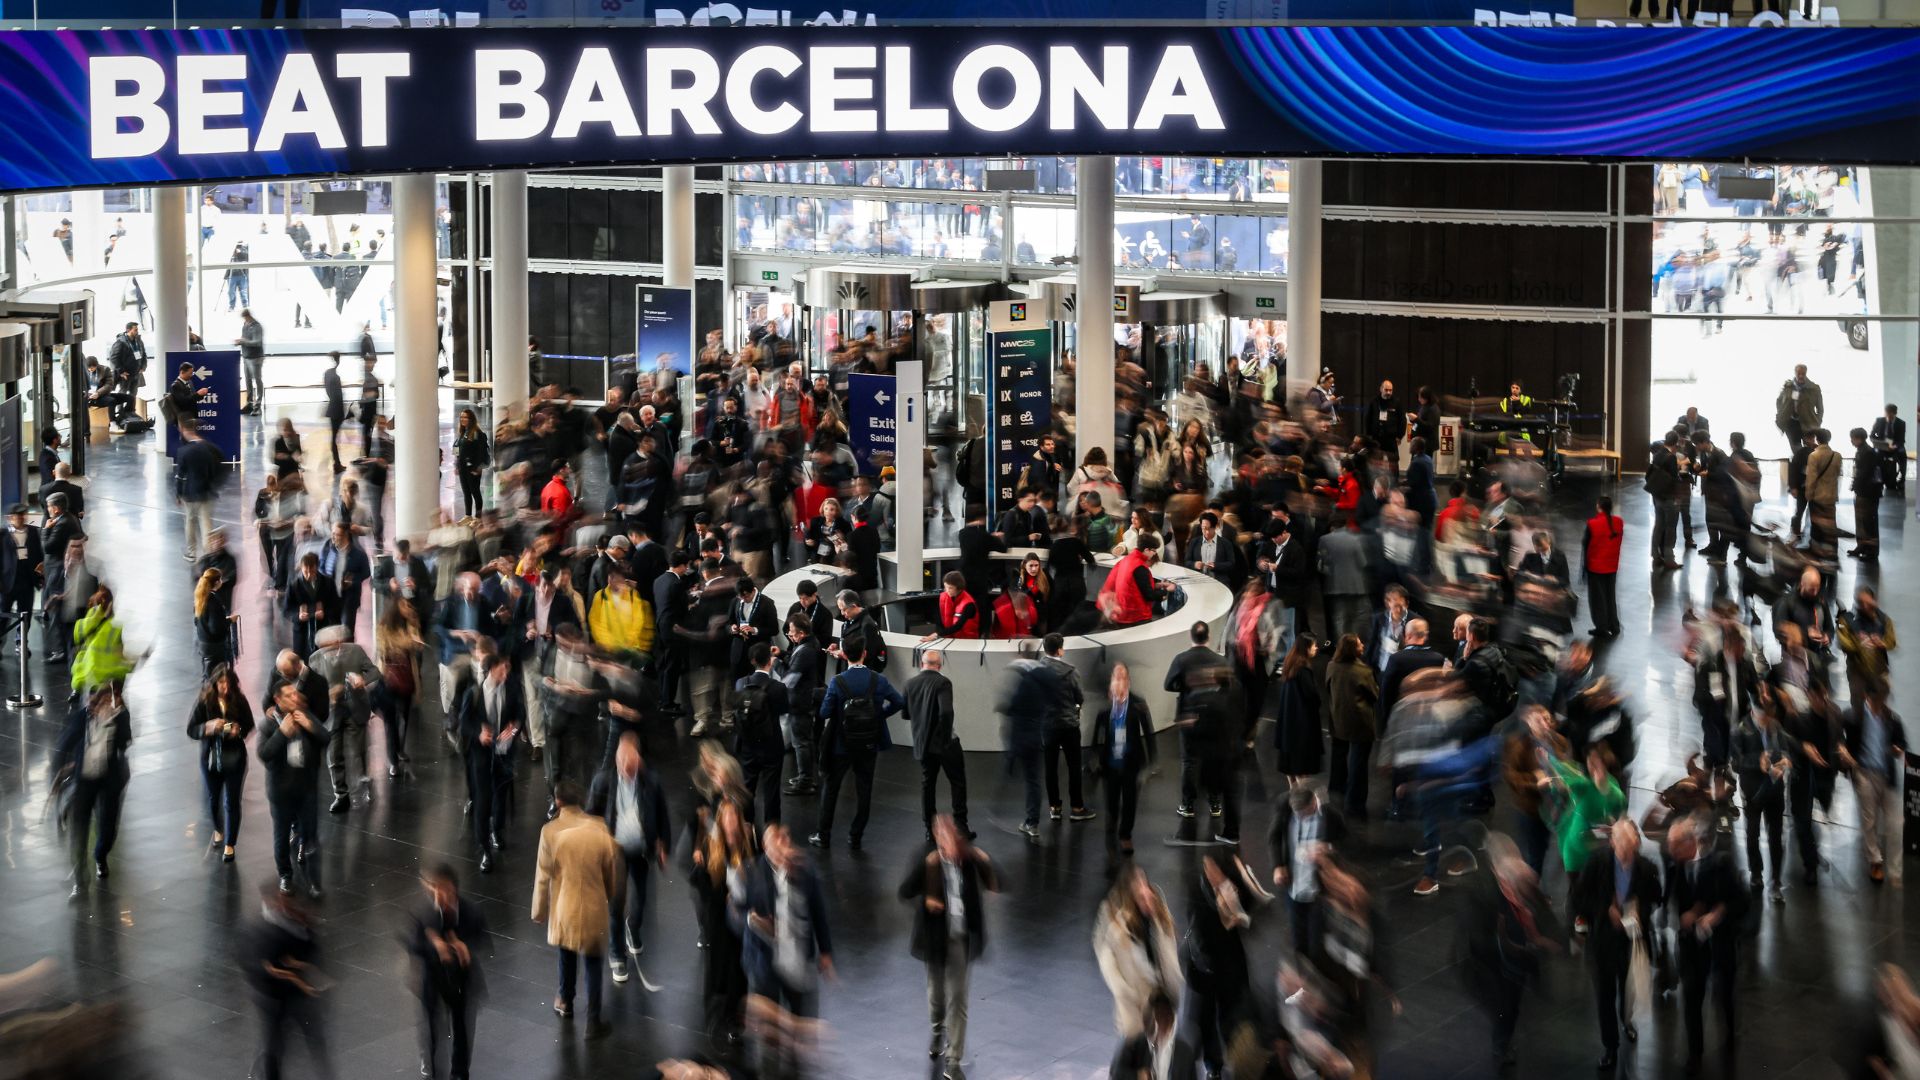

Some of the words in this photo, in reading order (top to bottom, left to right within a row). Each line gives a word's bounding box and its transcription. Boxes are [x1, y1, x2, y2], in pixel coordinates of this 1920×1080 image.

[89, 52, 410, 159] BEAT
[475, 44, 1226, 141] BARCELONA
[1000, 339, 1035, 348] MWC25
[197, 392, 218, 404] xit
[1020, 390, 1042, 398] HONOR
[869, 416, 895, 429] Exit
[870, 433, 895, 443] Salida
[1002, 488, 1013, 499] 5G
